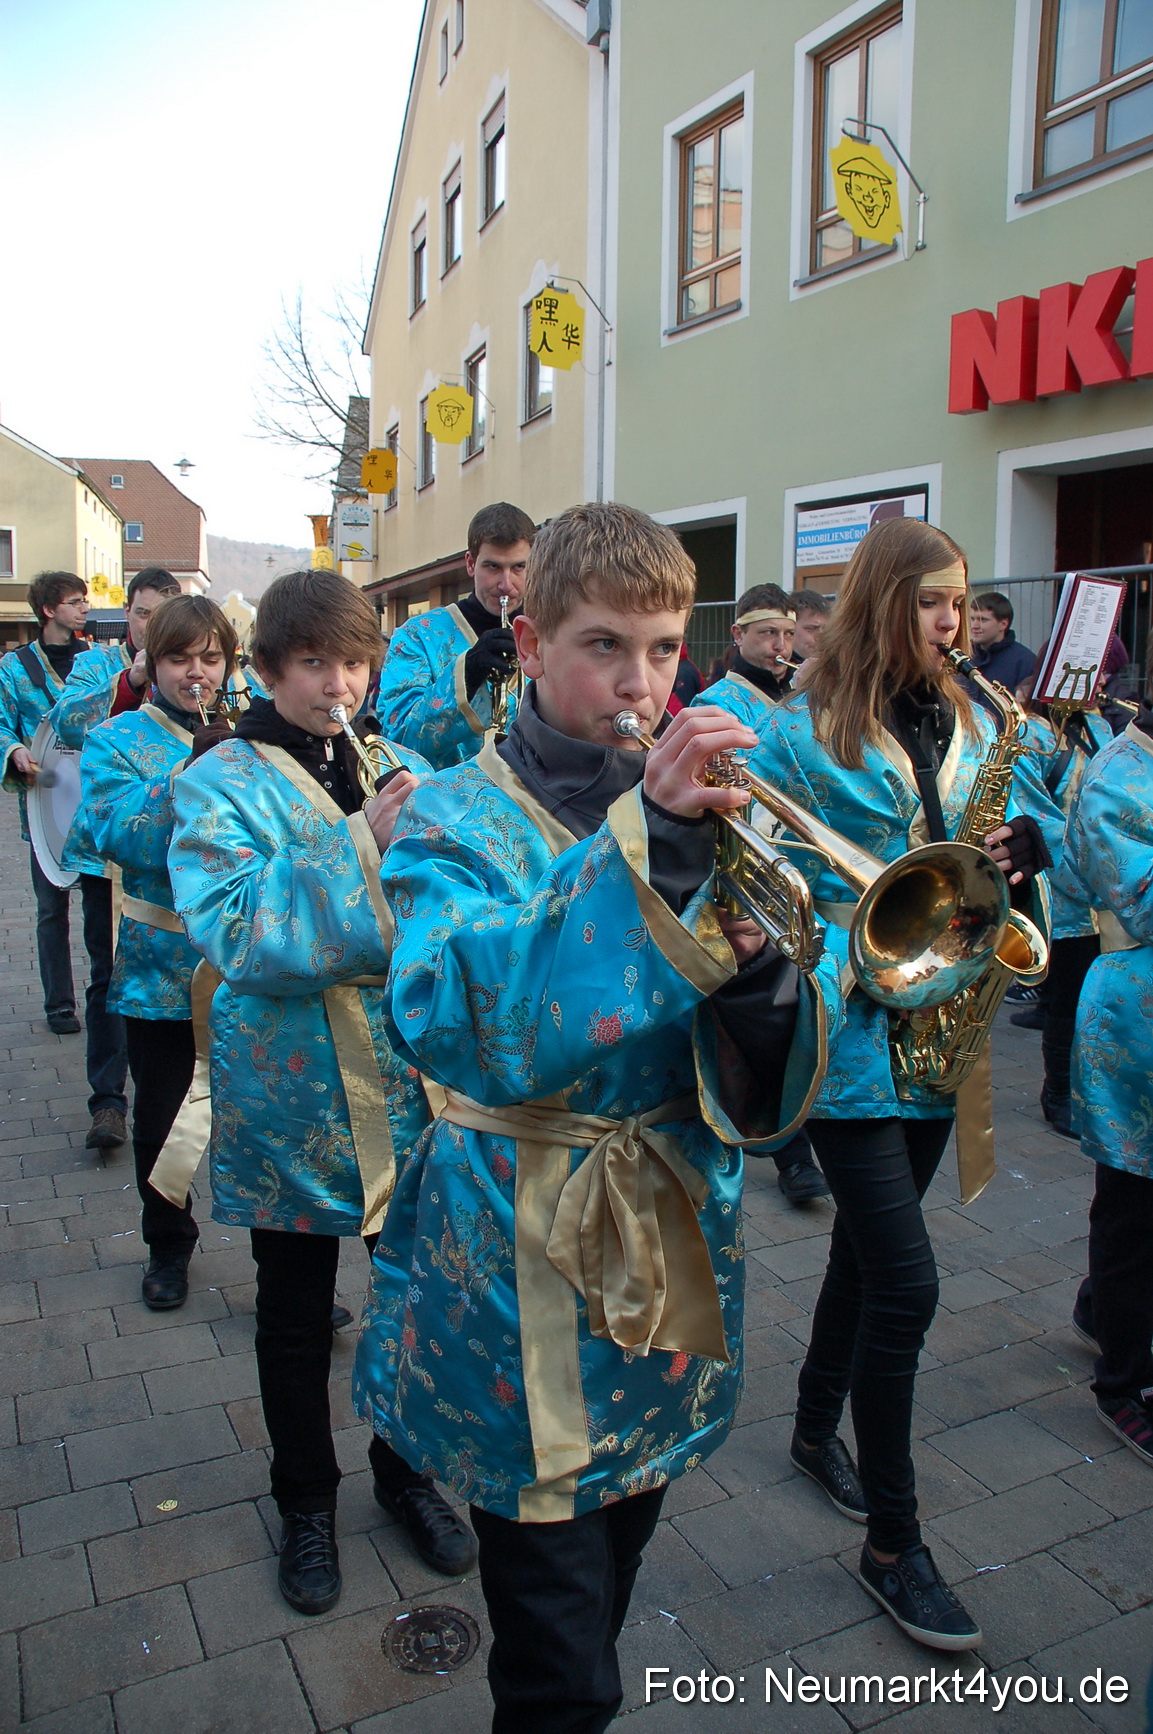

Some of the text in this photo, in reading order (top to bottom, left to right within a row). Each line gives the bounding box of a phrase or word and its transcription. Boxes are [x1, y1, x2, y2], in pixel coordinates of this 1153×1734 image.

[536, 330, 554, 354] 人
[948, 256, 1153, 416] NK
[798, 528, 867, 546] IMMOBILIENBÜRO
